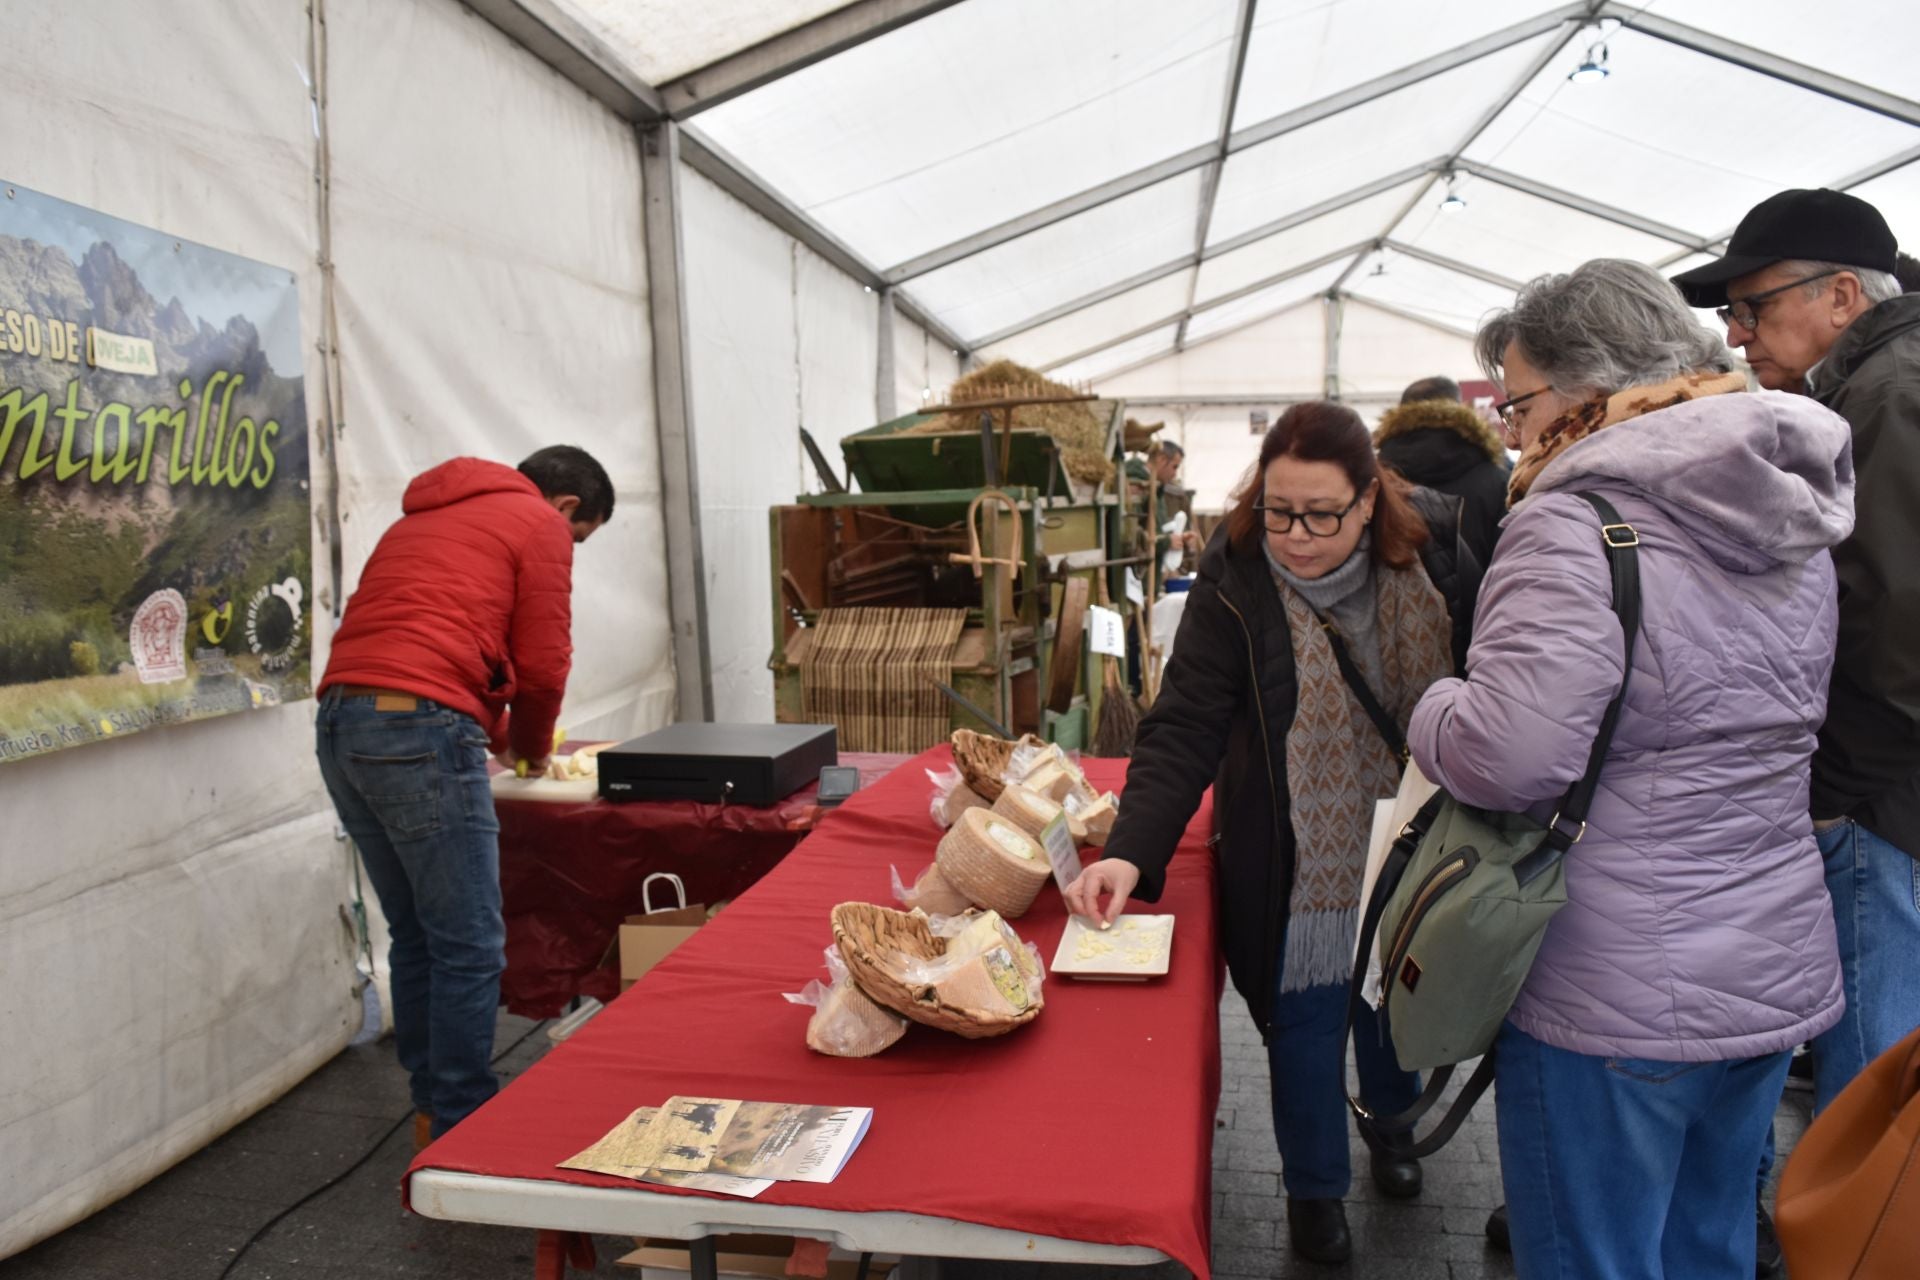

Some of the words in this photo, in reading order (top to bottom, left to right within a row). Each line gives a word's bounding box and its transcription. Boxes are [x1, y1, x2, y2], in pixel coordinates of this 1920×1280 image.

[48, 318, 80, 364] DE
[97, 335, 151, 366] OVEJA
[0, 369, 280, 490] ntarillos
